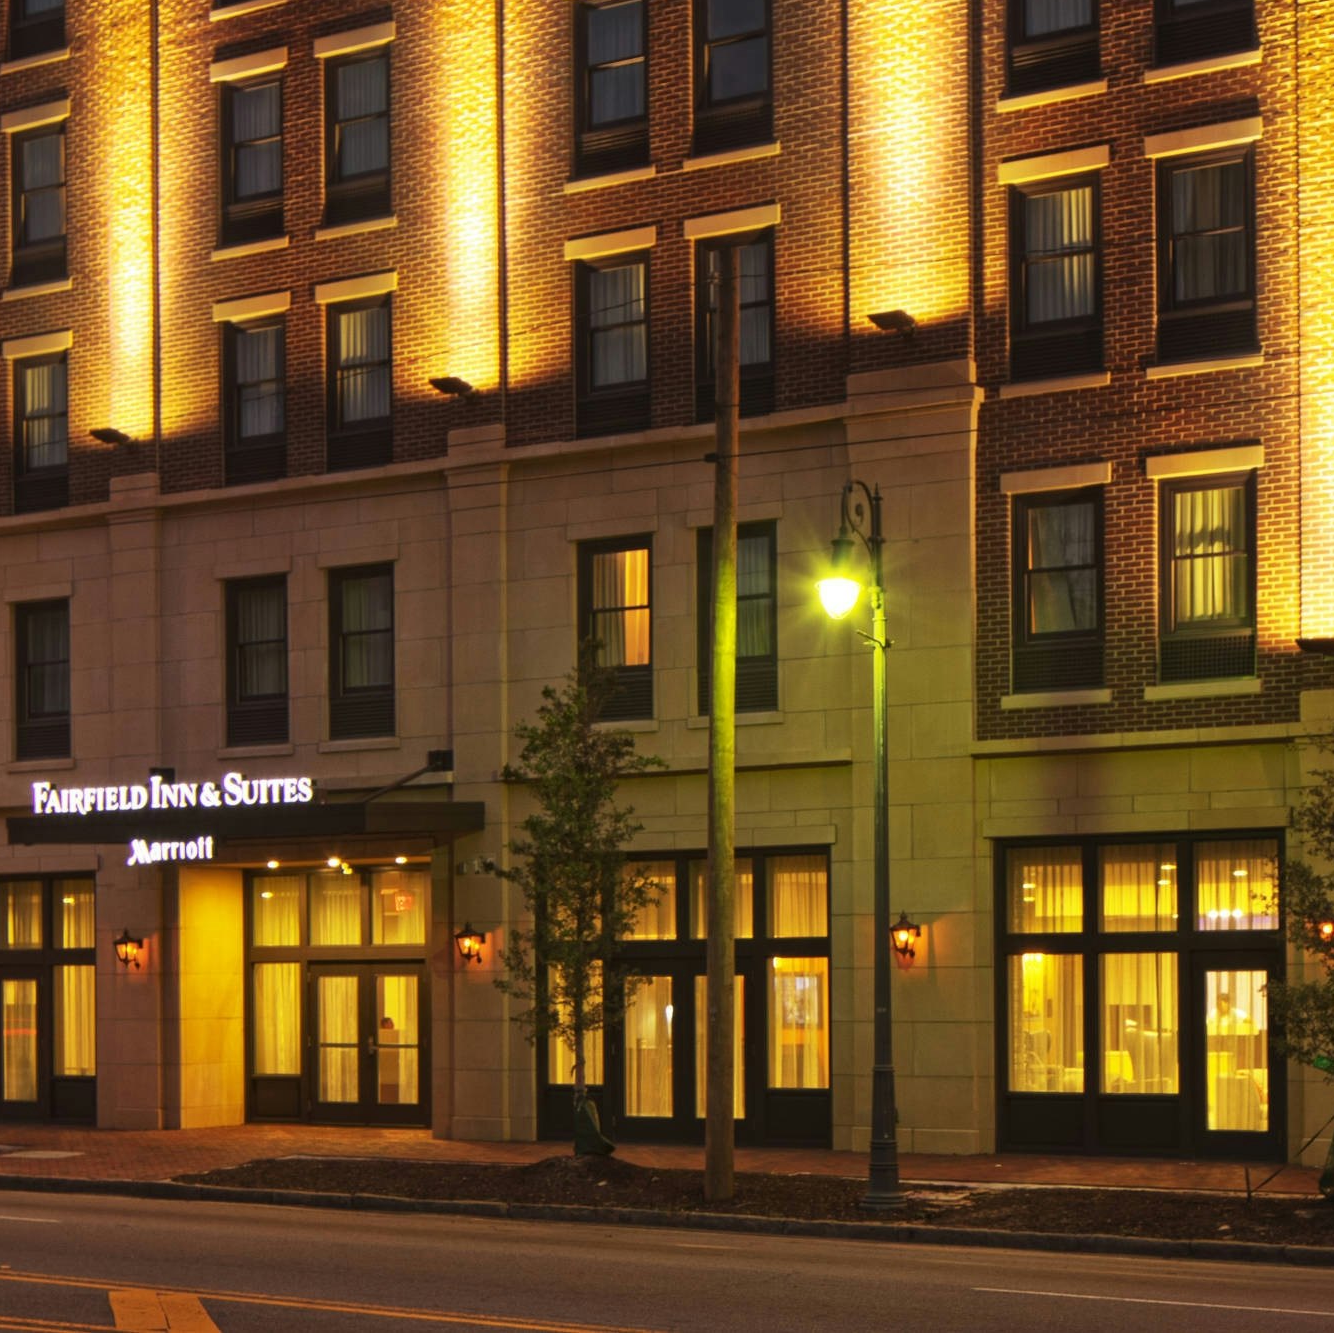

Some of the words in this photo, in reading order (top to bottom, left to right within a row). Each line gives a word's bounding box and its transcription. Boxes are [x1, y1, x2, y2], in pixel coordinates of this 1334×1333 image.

[32, 781, 149, 815] FAIRFIELD
[149, 775, 198, 809] INN
[200, 782, 222, 808] &
[223, 772, 313, 806] SUITES
[127, 836, 213, 866] Marriott
